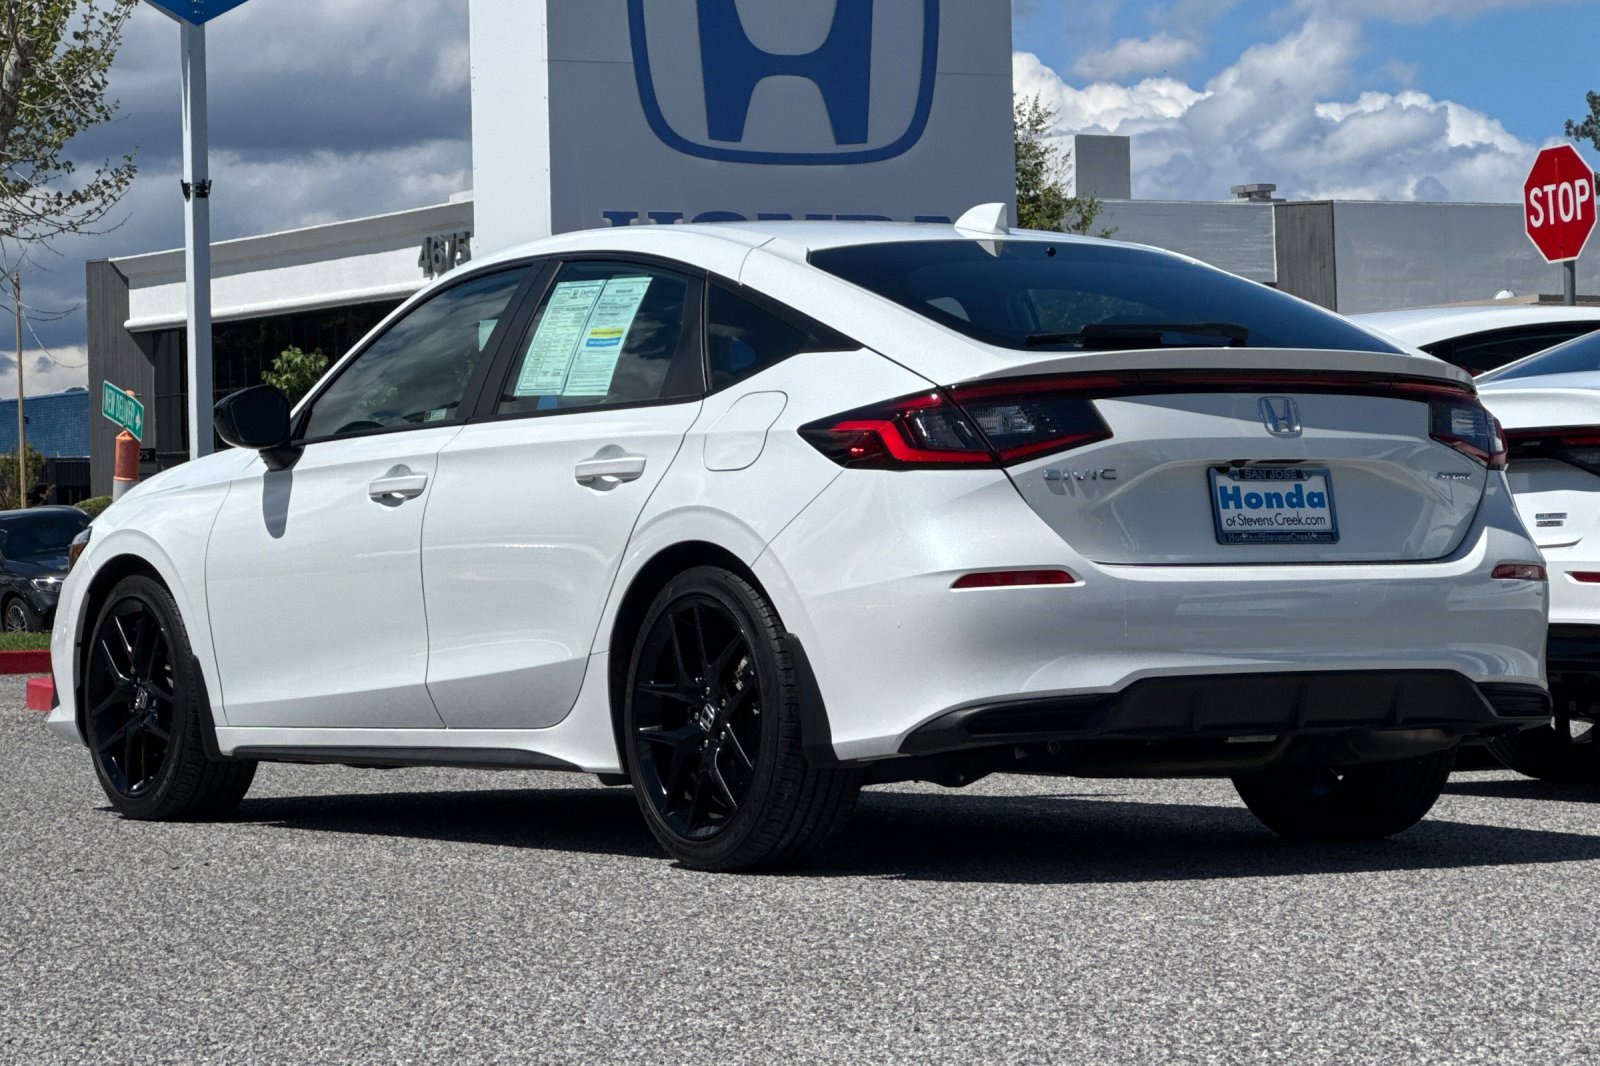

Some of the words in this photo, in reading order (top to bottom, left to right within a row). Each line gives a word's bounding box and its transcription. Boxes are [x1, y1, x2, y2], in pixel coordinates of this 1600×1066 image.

[1529, 178, 1590, 228] STOP
[418, 231, 472, 280] 4675
[1043, 468, 1117, 481] CIVIC
[1244, 469, 1267, 479] SAN
[1270, 469, 1298, 479] JOSE
[1218, 483, 1327, 510] Honda
[1226, 518, 1237, 527] of
[1238, 513, 1274, 527] Stevens
[1275, 511, 1326, 527] Creek.com
